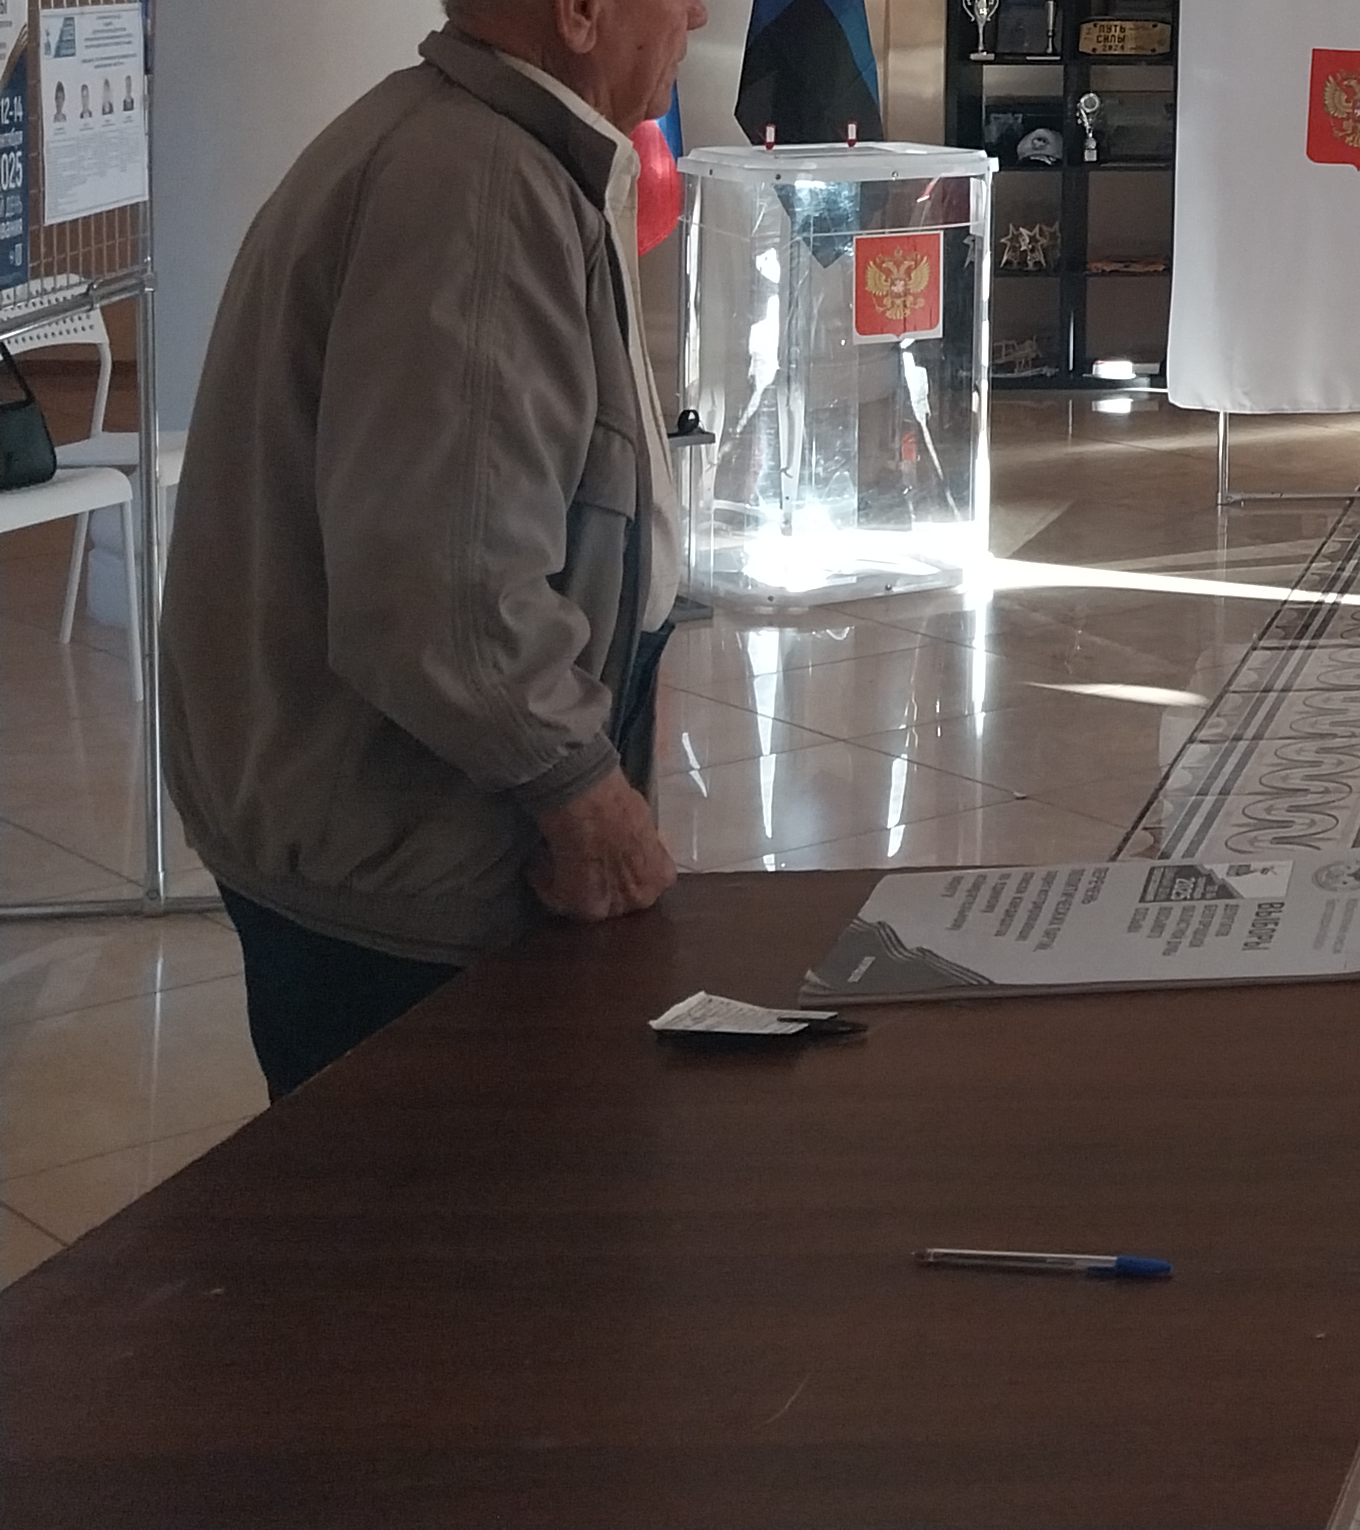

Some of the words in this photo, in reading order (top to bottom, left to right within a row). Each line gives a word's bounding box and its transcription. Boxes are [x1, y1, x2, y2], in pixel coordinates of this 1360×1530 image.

[1096, 34, 1127, 44] СИЛЫ
[1098, 24, 1127, 34] ПУТЬ
[0, 150, 23, 190] 025
[1242, 901, 1286, 952] ВЫБОРЫ
